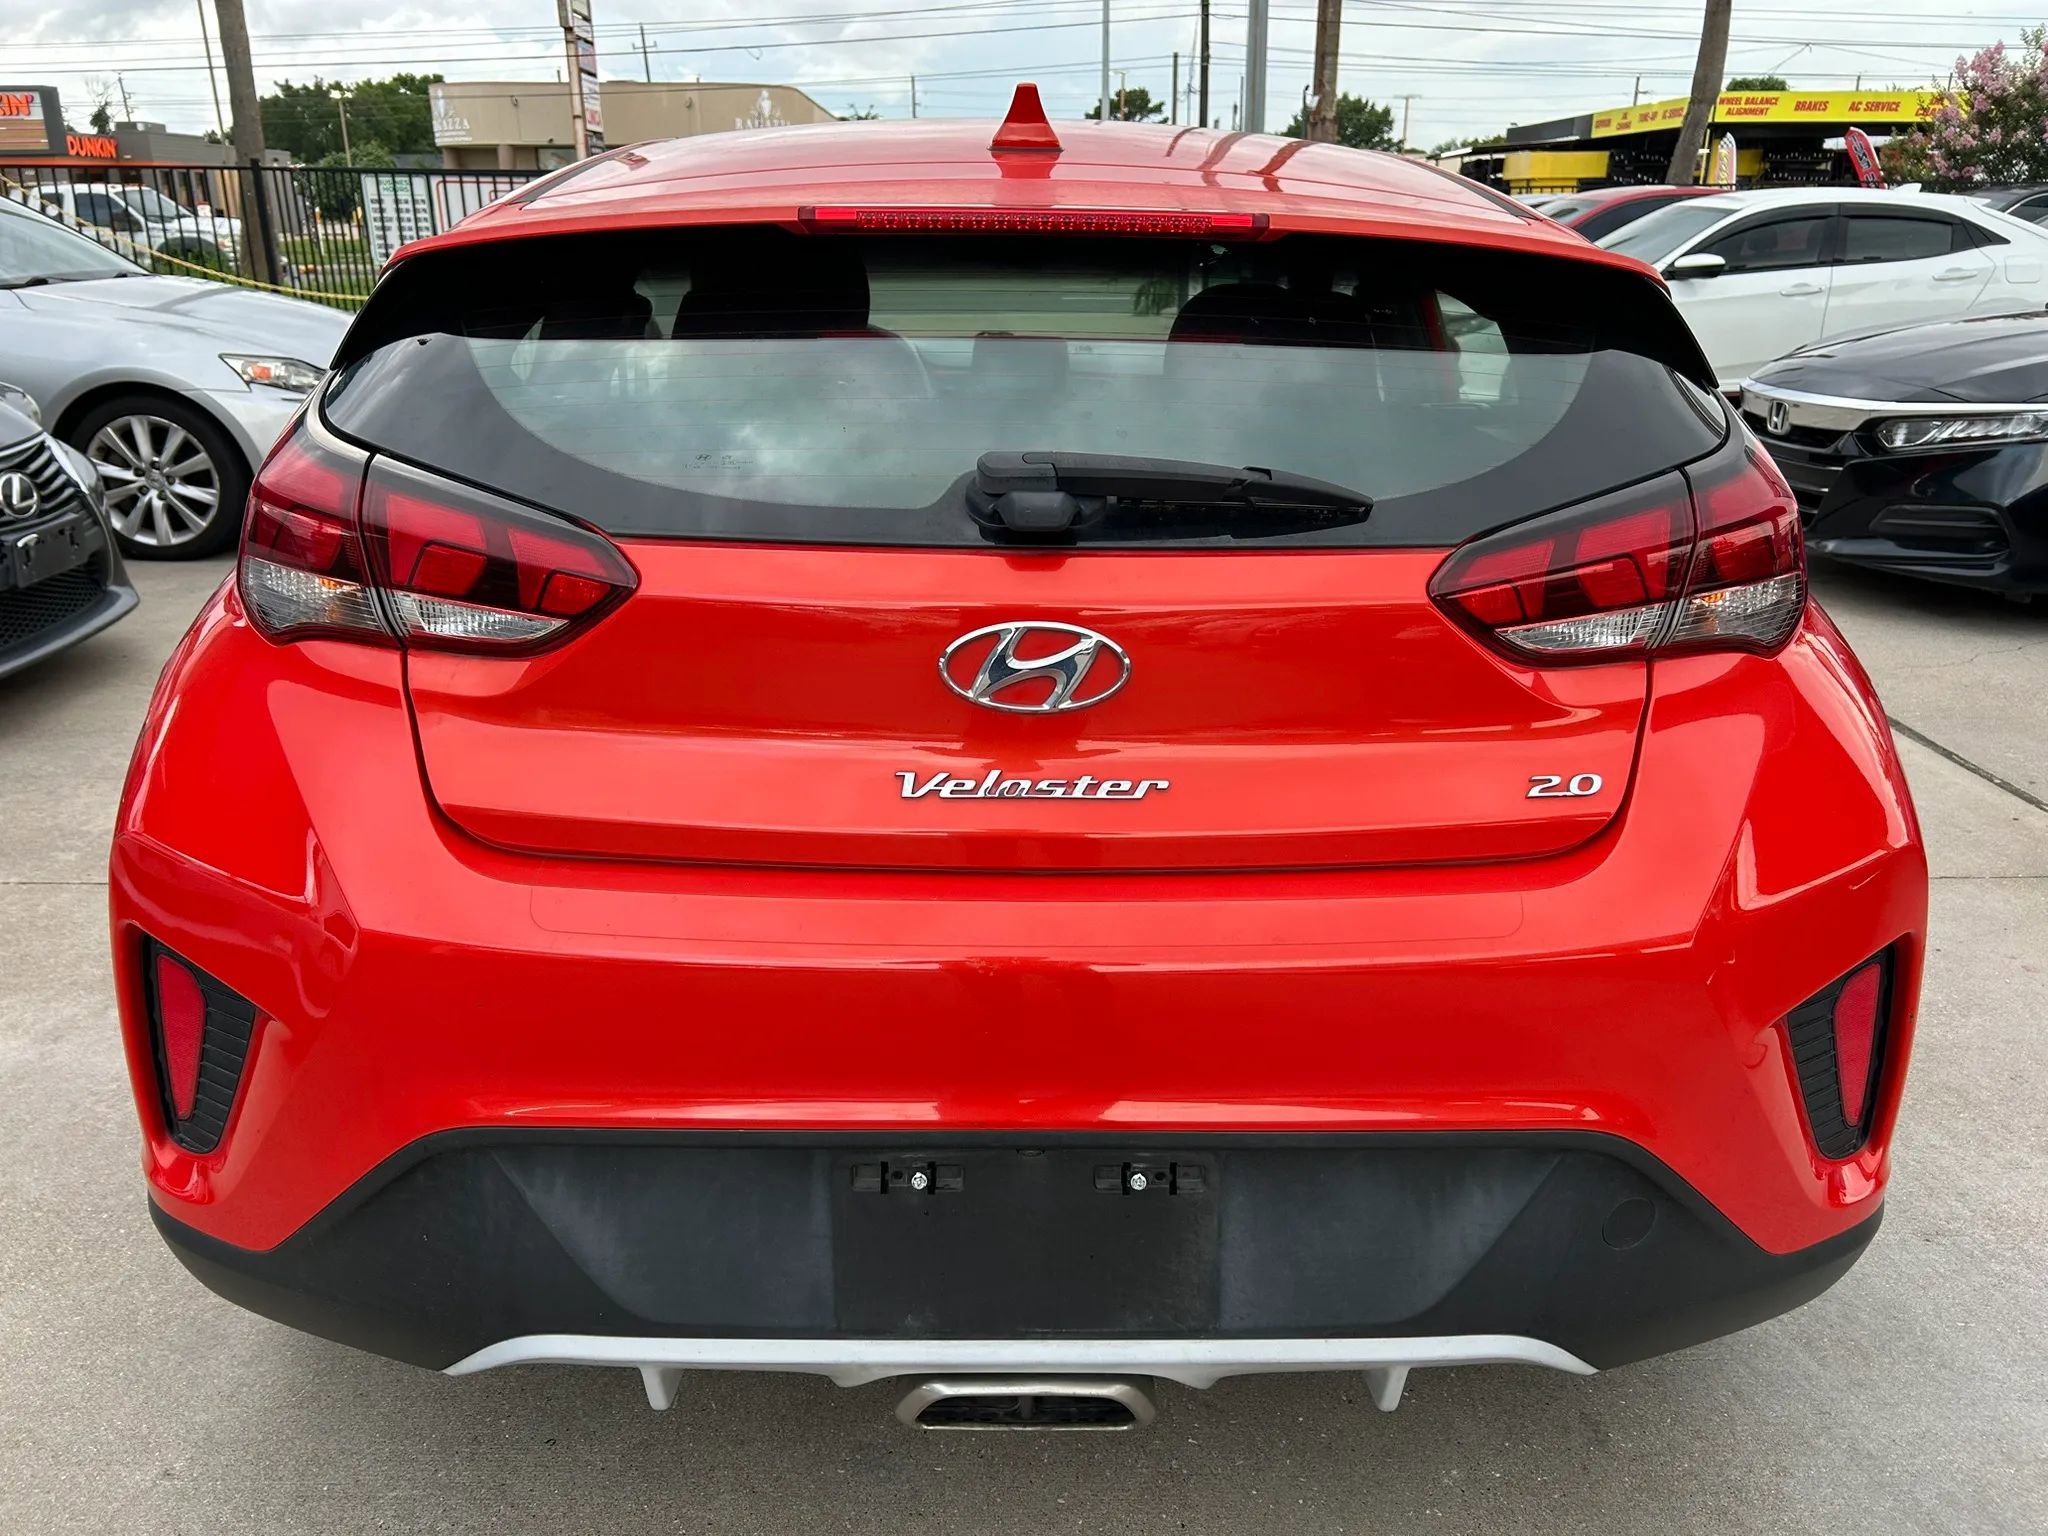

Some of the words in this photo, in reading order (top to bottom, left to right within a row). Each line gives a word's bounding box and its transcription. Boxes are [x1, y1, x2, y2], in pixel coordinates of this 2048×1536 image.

[1719, 97, 1742, 105] WHEEL
[1744, 97, 1779, 105] BALANCE
[1794, 101, 1829, 111] BRAKES
[1726, 107, 1769, 116] ALIGNMENT
[1848, 101, 1861, 112] AC
[1863, 102, 1901, 112] SERVICE
[895, 769, 1170, 800] Veloster
